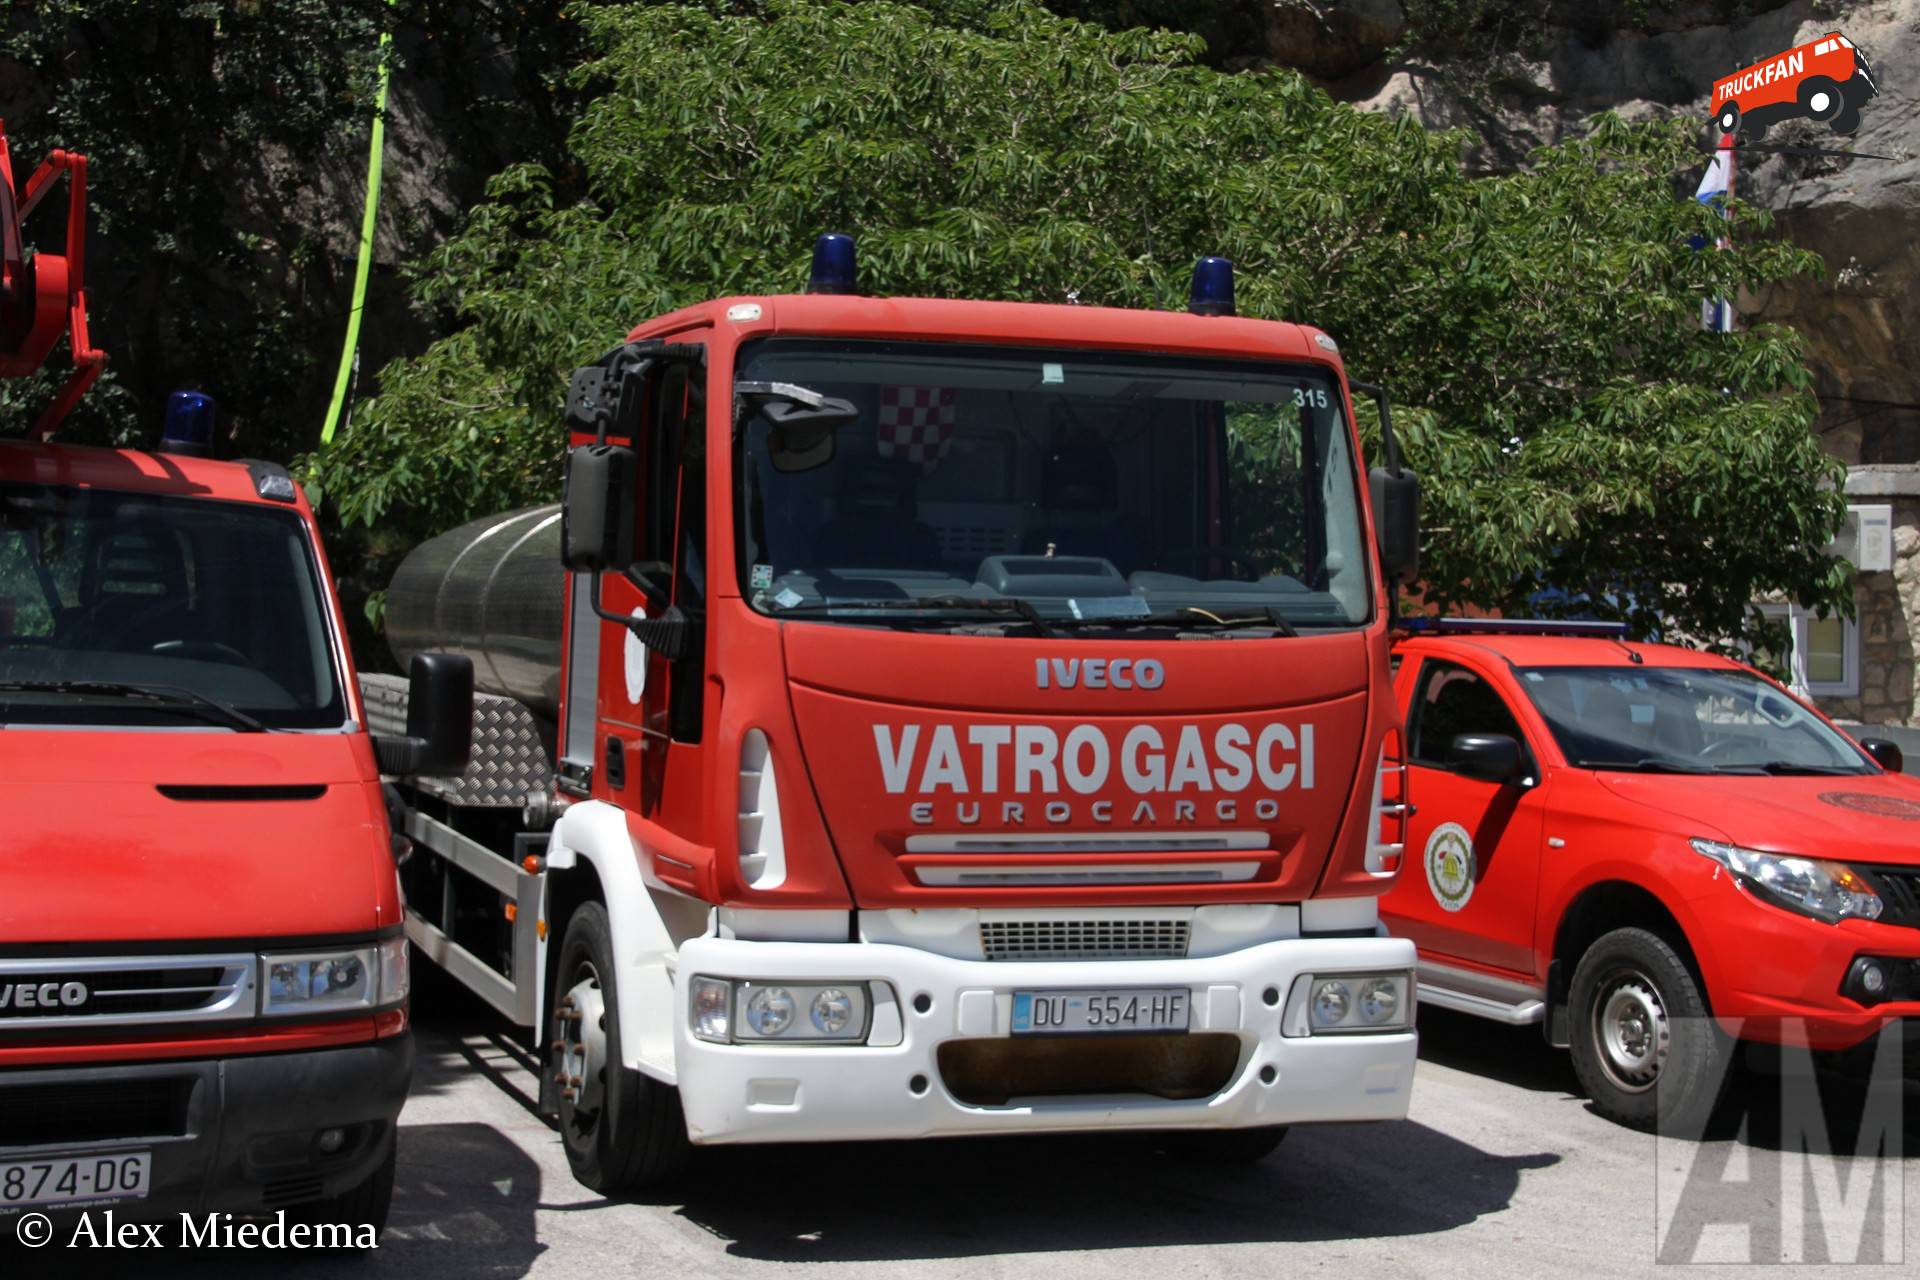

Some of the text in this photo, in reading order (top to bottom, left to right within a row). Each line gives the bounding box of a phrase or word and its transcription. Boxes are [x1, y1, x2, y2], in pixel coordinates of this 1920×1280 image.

[1293, 388, 1327, 408] 315
[1035, 658, 1165, 689] IVECO
[910, 800, 1279, 823] EUROCARGO
[1033, 995, 1183, 1026] DU 554-HF
[3, 1157, 141, 1200] 874-DG
